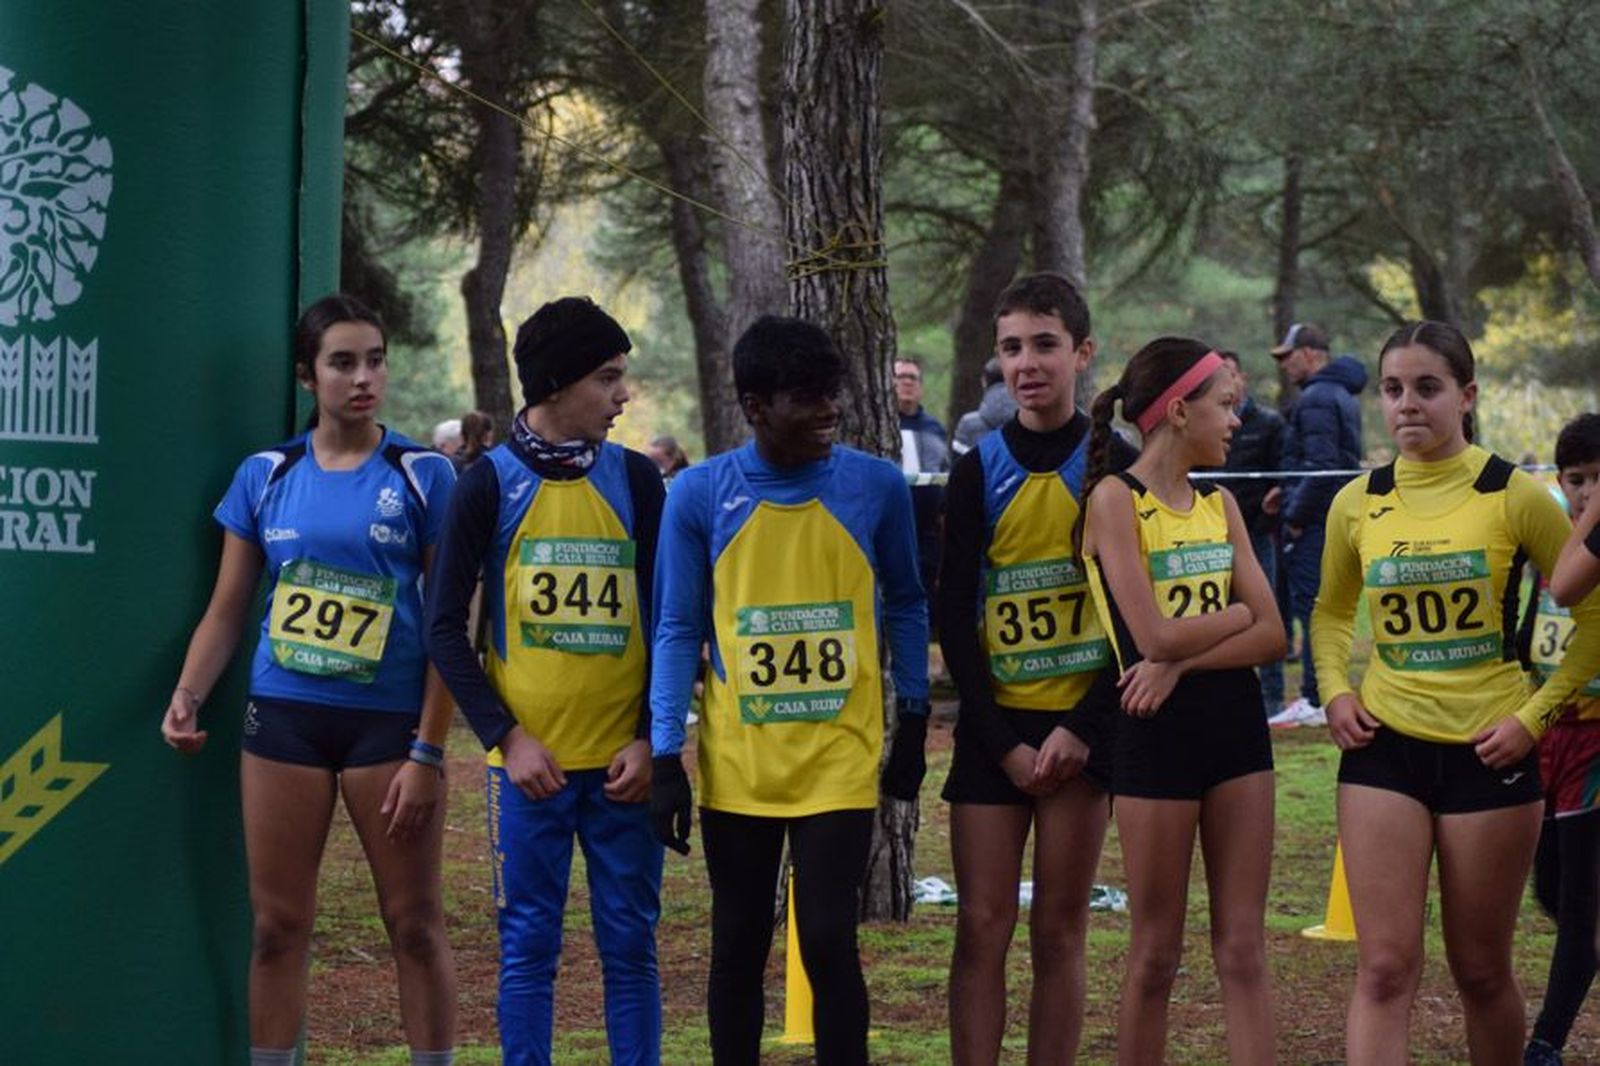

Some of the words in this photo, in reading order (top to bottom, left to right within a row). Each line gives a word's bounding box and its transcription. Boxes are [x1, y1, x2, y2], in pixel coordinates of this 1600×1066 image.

[0, 466, 97, 508] ION
[1400, 556, 1473, 573] FUNDACION
[1432, 568, 1474, 581] RURAL
[530, 572, 623, 618] 344
[281, 592, 379, 648] 297
[771, 608, 838, 620] FUNDACION
[997, 591, 1088, 645] 357
[1380, 587, 1484, 636] 302
[803, 618, 839, 630] RURAL
[588, 631, 626, 646] RURAL
[1057, 647, 1101, 666] RURAL
[1448, 642, 1497, 659] RURAL
[749, 637, 846, 687] 348
